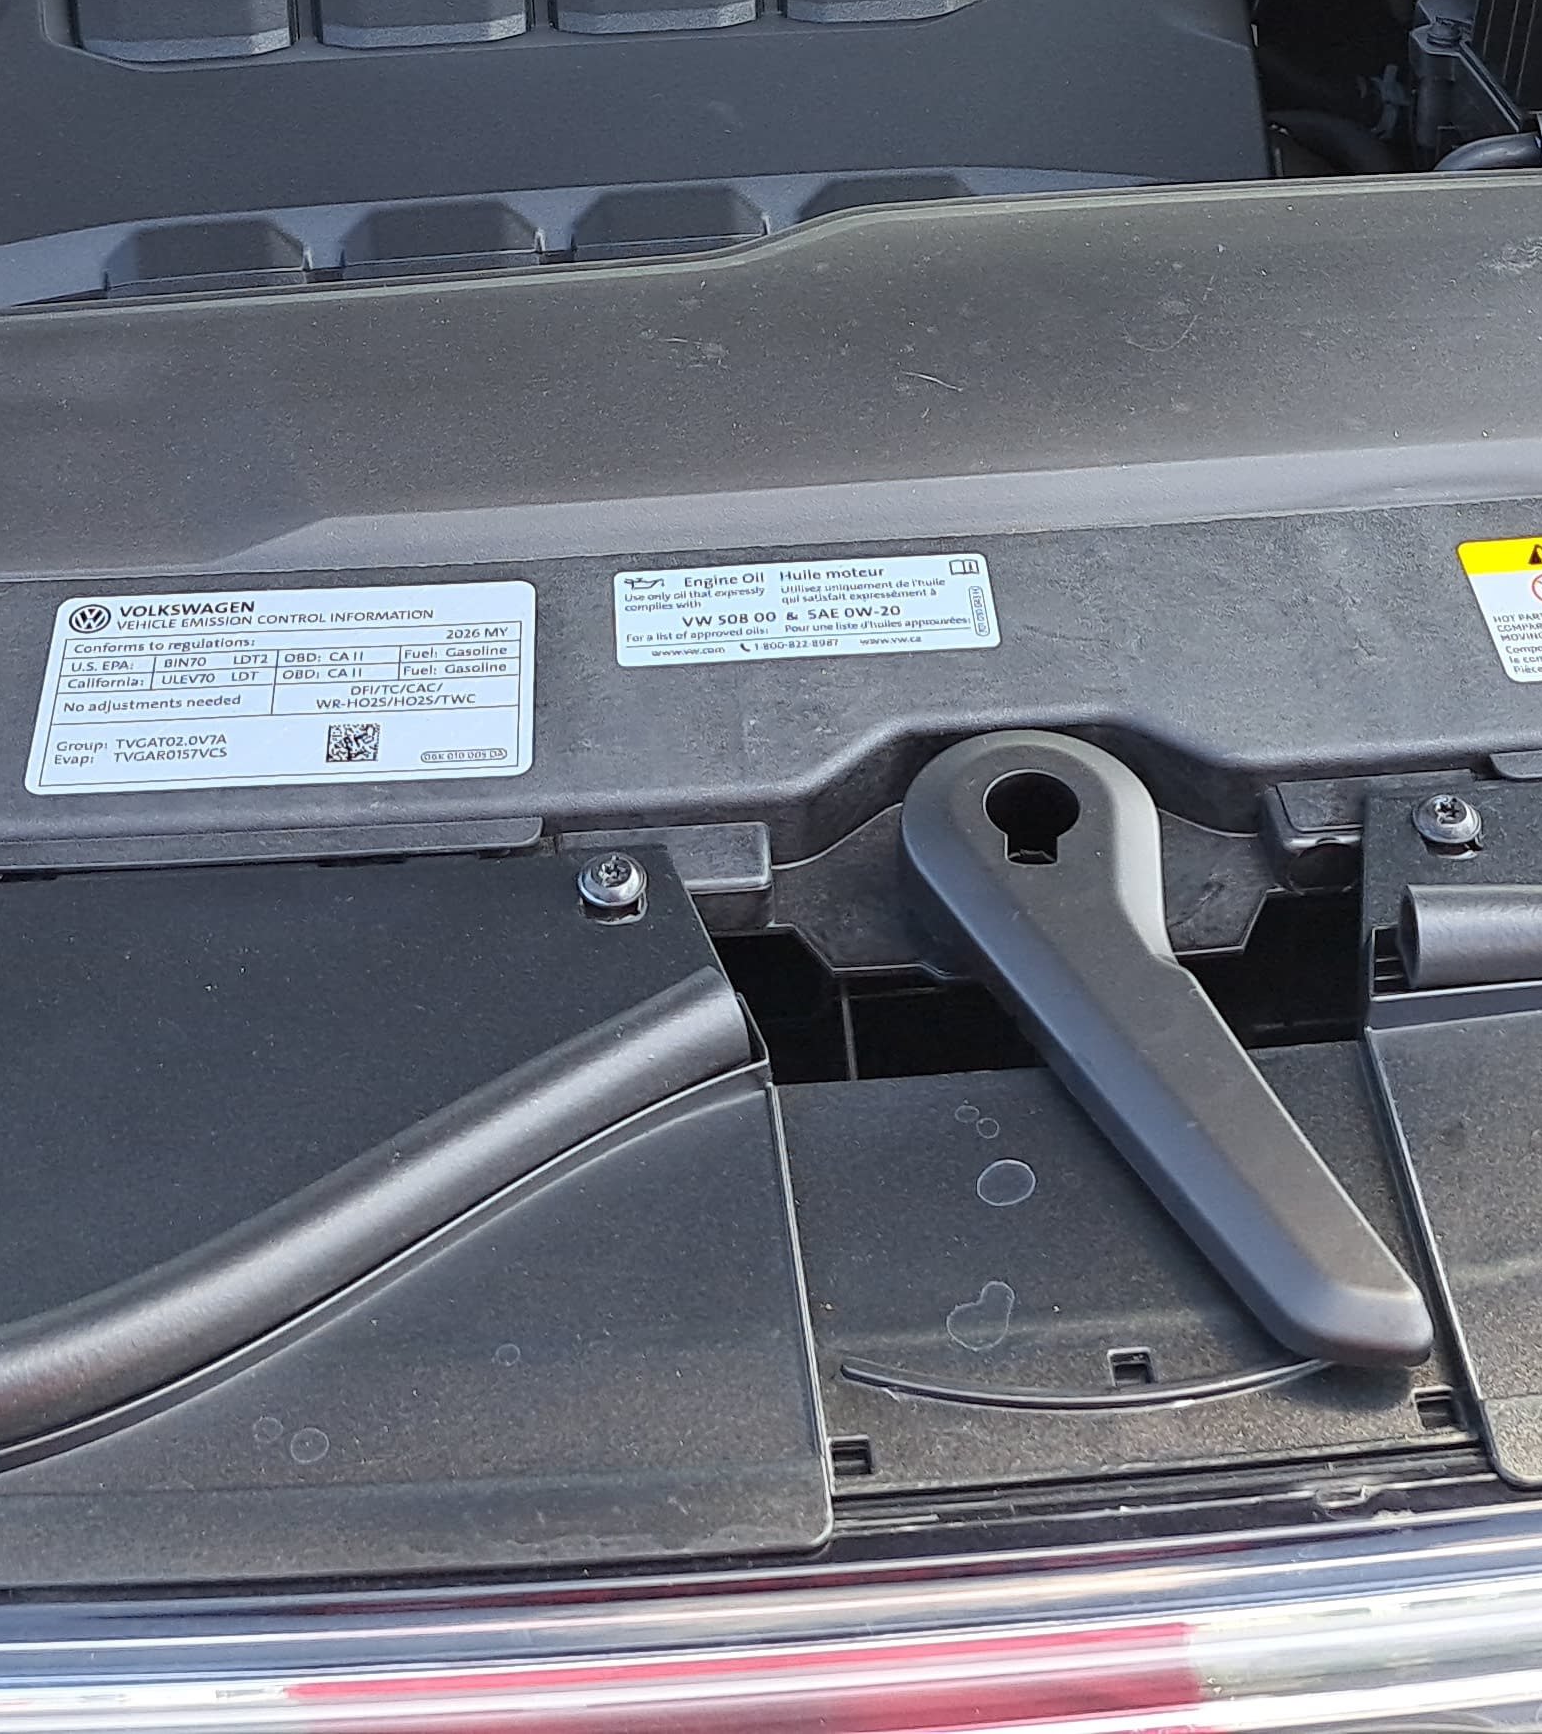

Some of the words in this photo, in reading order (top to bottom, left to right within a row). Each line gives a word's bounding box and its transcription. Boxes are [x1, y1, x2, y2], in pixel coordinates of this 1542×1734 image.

[684, 575, 738, 590] Engine
[742, 572, 765, 584] Oil
[780, 569, 821, 582] Huile
[825, 567, 885, 580] moteur
[781, 584, 821, 594] Utilisez
[825, 579, 893, 592] uniquement
[896, 579, 910, 588] de
[912, 577, 946, 587] l'huile
[624, 593, 646, 603] Use
[647, 591, 671, 603] only
[673, 590, 687, 600] oil
[689, 588, 711, 599] that
[714, 586, 765, 598] expressly
[781, 594, 800, 606] qui
[802, 591, 846, 603] satisfait
[119, 600, 255, 617] VOLKSWAGEN
[624, 602, 673, 613] complies
[676, 600, 702, 610] with
[118, 618, 176, 631] VEHICLE
[181, 616, 253, 629] EMISSION
[257, 613, 326, 626] CONTROL
[330, 609, 434, 623] INFORMATION
[682, 616, 714, 628] VW
[718, 613, 749, 626] 508
[754, 611, 777, 623] 00
[786, 611, 799, 621] &
[808, 607, 840, 620] SAE
[844, 605, 901, 619] 0W-20
[1493, 615, 1515, 623] HOT
[445, 628, 480, 640] 2026
[484, 626, 508, 638] MY
[785, 623, 809, 633] Pour
[812, 623, 834, 631] une
[835, 620, 858, 630] liste
[626, 633, 645, 643] For
[656, 631, 673, 641] list
[675, 630, 688, 640] of
[690, 627, 743, 640] approved
[860, 636, 922, 646] www.vw.ca
[74, 641, 145, 654] Conforms
[149, 641, 165, 651] to
[168, 637, 255, 652] regulations:
[404, 648, 438, 660] Fuel:
[445, 646, 508, 658] Gasoline
[651, 647, 726, 657] www.vw.com
[71, 661, 98, 672] U.S.
[102, 659, 134, 671] EPA:
[164, 656, 207, 667] BIN70
[233, 653, 268, 665] LDT2
[284, 652, 321, 663] OBD:
[329, 651, 349, 662] CA
[1509, 655, 1520, 664] le
[403, 665, 437, 676] Fuel:
[444, 662, 507, 674] Gasoline
[67, 677, 144, 690] California:
[162, 673, 216, 685] ULEV70
[231, 671, 259, 683] LDT
[282, 669, 320, 680] OBD:
[327, 668, 348, 679] CA
[350, 682, 443, 696] DFI/TC/CAC/
[63, 701, 84, 713] No
[88, 697, 183, 714] adjustments
[186, 694, 241, 708] needed
[316, 694, 477, 709] WR-HO2S/HO2S/TWC
[56, 740, 108, 753] Group:
[54, 754, 95, 766] Evap:
